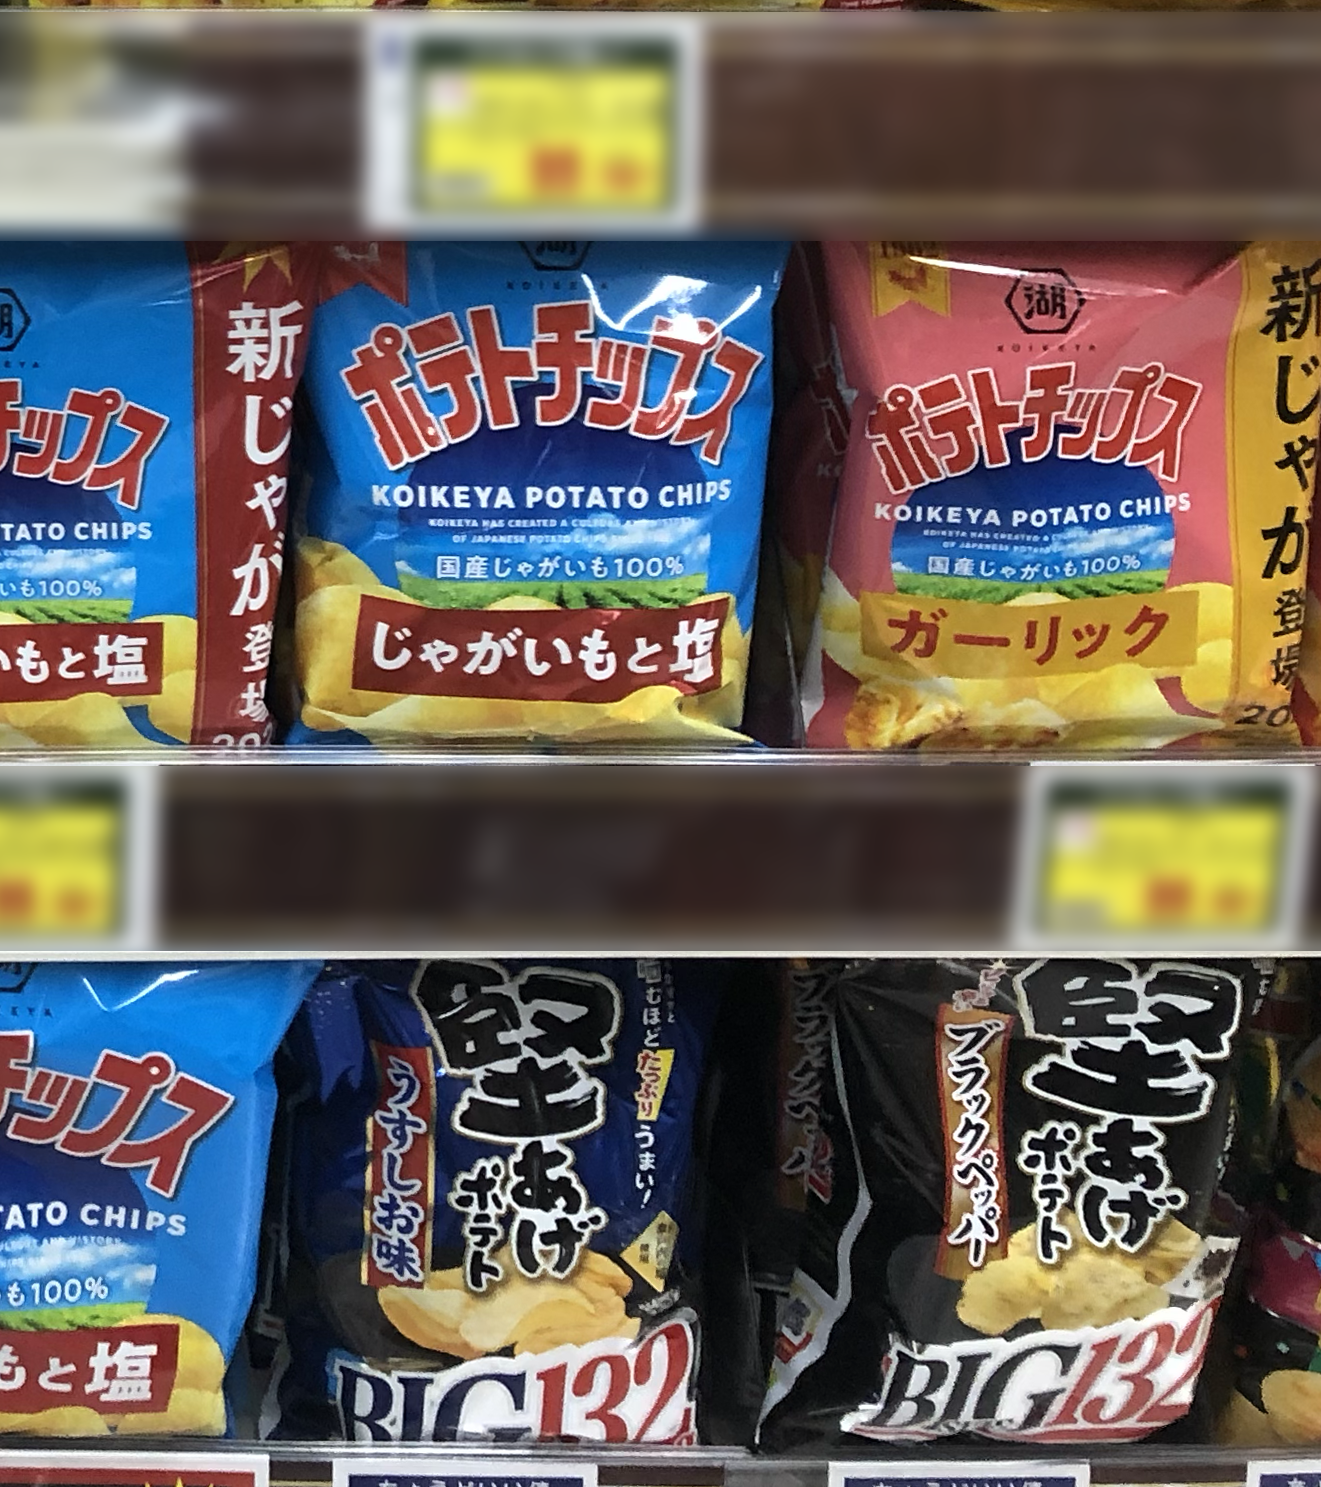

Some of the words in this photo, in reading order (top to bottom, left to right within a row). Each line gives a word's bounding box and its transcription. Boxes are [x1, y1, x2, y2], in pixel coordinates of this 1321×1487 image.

[340, 301, 763, 470] ポテトチップス
[866, 362, 1202, 494] ポテトチップス
[373, 485, 514, 508] KOIKEYA
[526, 486, 649, 509] POTATO
[659, 479, 733, 505] CHIPS
[875, 503, 1001, 526] KOIKEYA
[1013, 503, 1111, 526] POTATO
[1121, 493, 1191, 518] CHIPS
[74, 521, 152, 541] CHIPS
[436, 554, 684, 580] 国産じゃがいも100%
[928, 555, 1141, 580] 国産じゃがいも100%
[373, 617, 719, 682] じゃがいもと塩
[887, 606, 1169, 665] ガーリック
[373, 1055, 426, 1281] うすしお味
[945, 1021, 1002, 1266] ブラックペッパー
[81, 1204, 187, 1235] CHIPS
[449, 1157, 509, 1291] ポテト
[1018, 1122, 1080, 1265] ポテト
